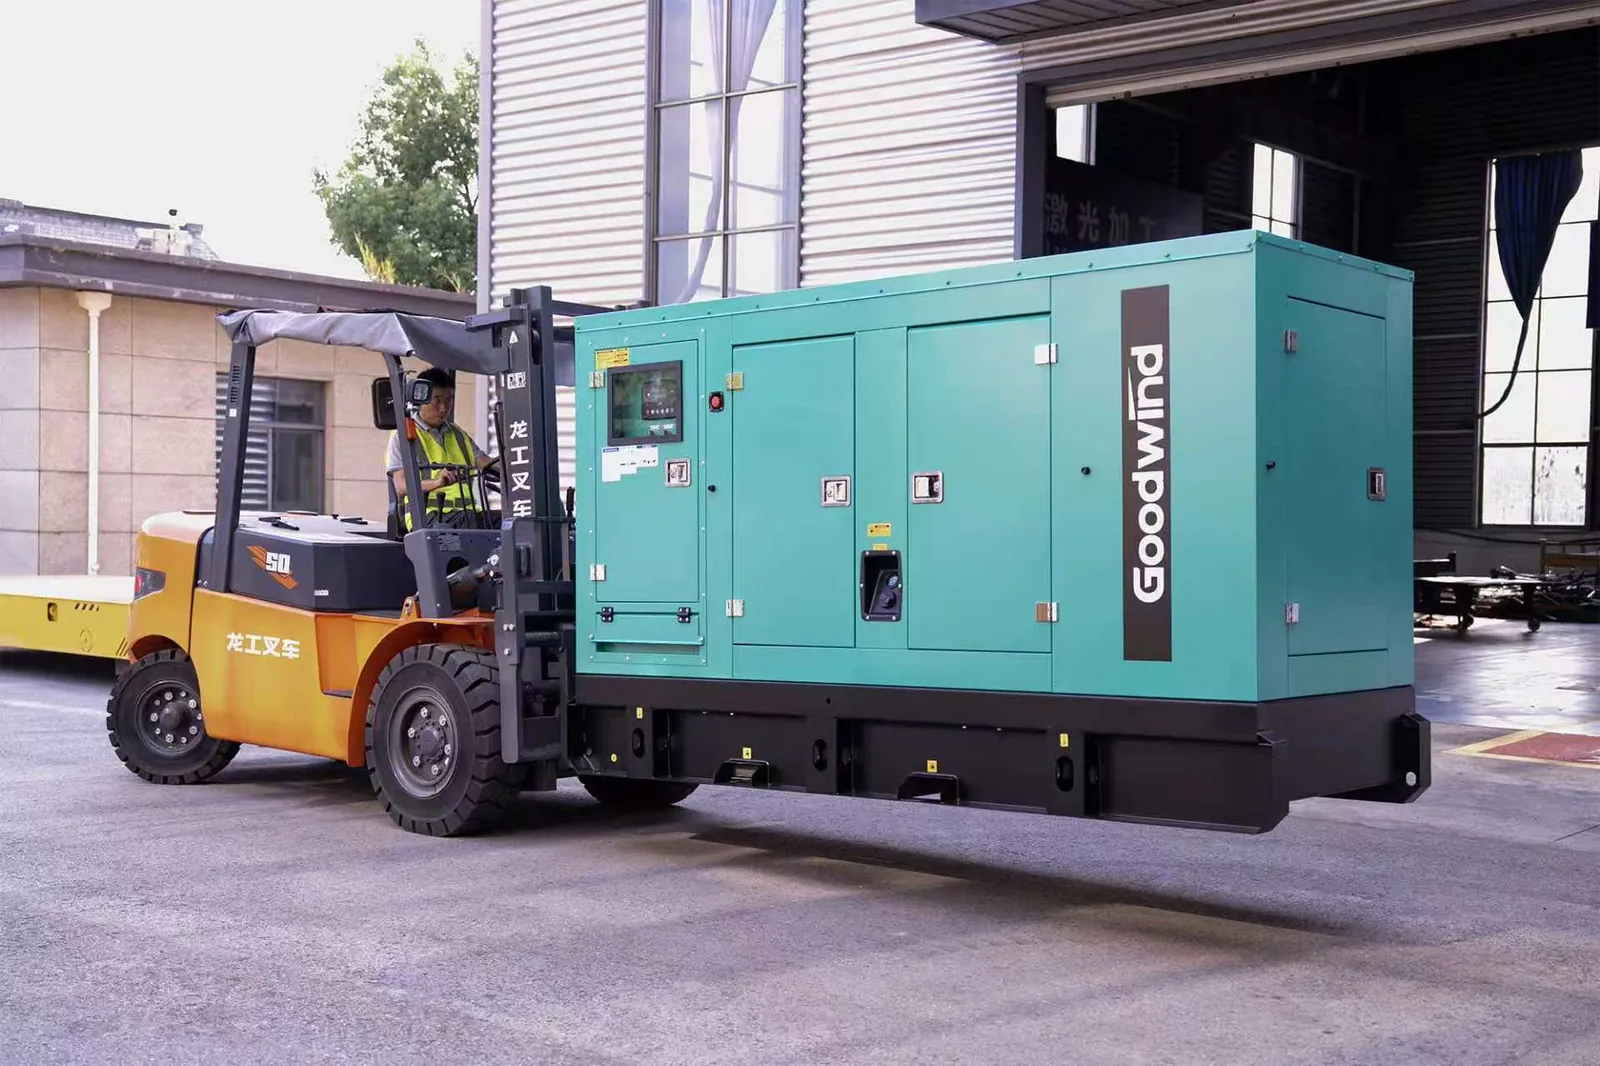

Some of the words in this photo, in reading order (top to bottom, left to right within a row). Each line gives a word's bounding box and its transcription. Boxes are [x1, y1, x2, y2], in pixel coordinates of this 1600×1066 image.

[509, 420, 533, 518] 龙工叉车
[1127, 343, 1166, 604] Goodwind
[265, 552, 291, 574] 50
[226, 632, 301, 659] 龙工叉车
